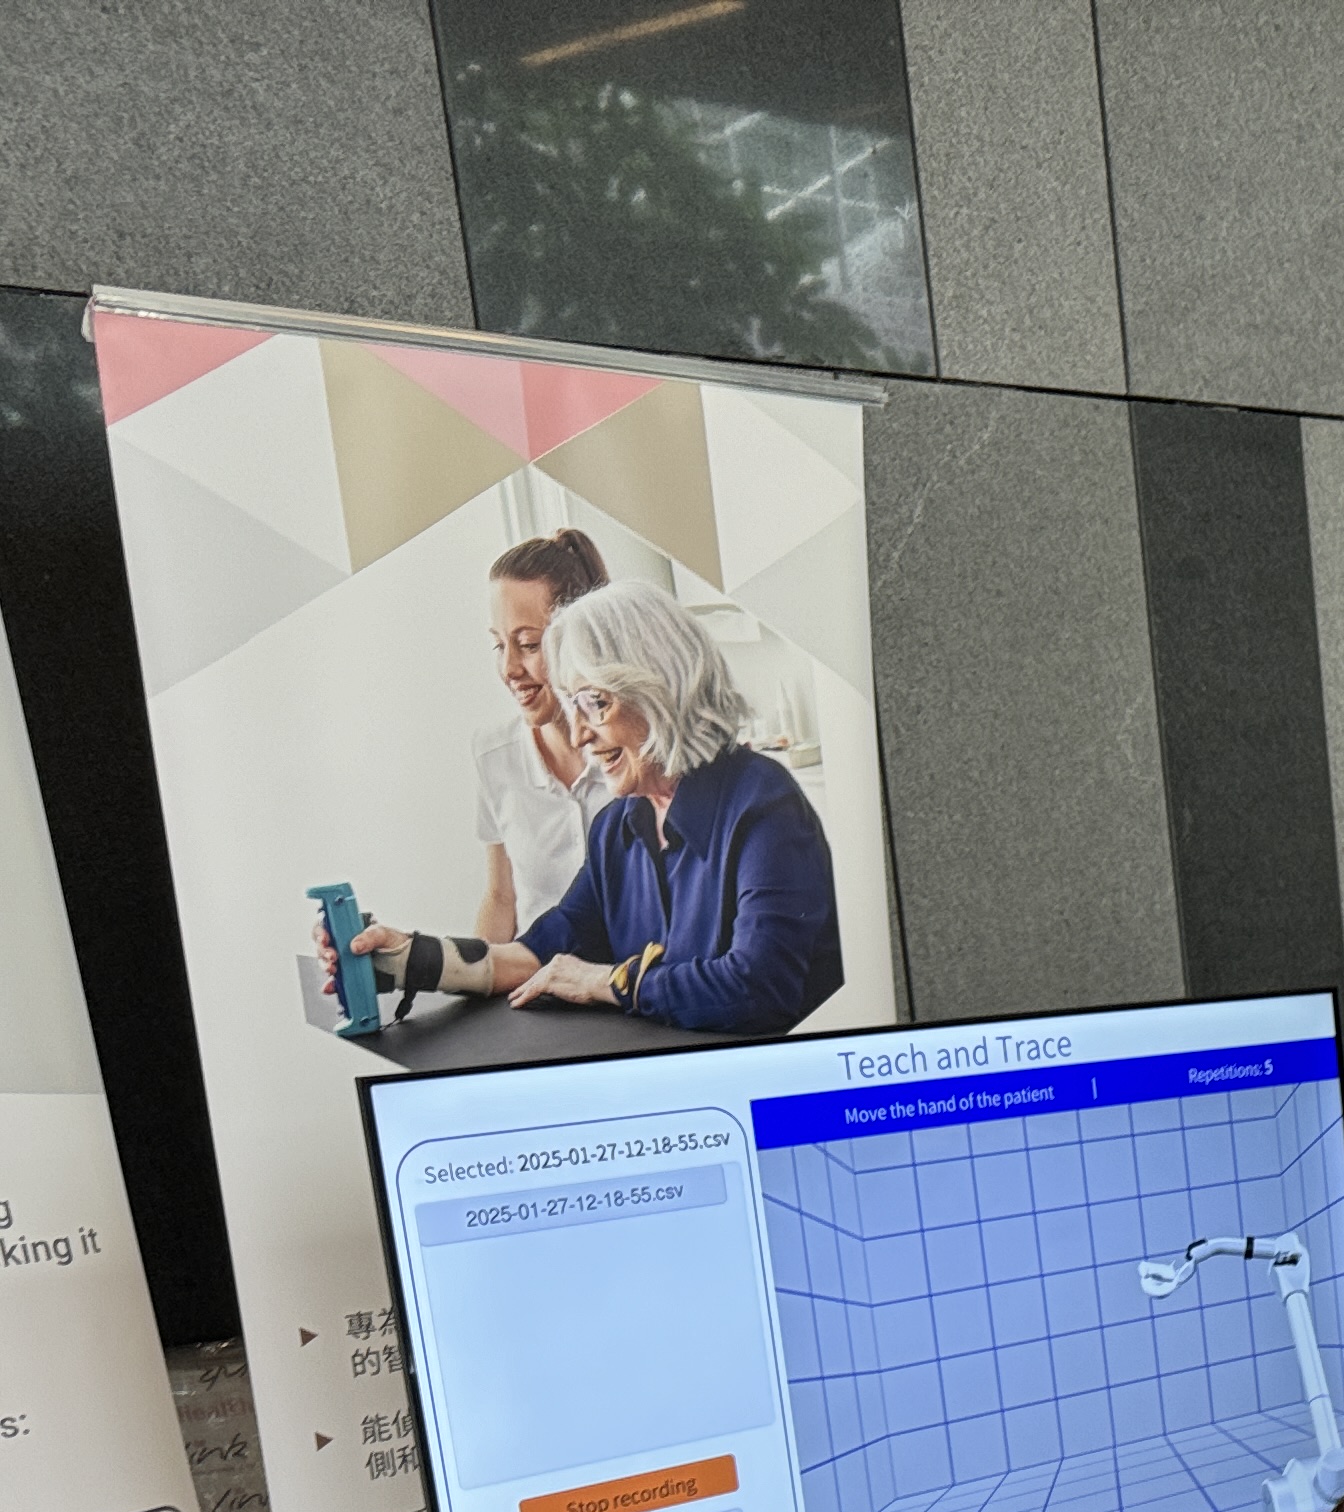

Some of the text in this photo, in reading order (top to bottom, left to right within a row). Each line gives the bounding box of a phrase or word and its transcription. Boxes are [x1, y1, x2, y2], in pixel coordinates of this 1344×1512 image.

[837, 1031, 1073, 1082] Teach and Trace
[1188, 1058, 1274, 1085] Repetitions: 5
[845, 1083, 1055, 1125] Move the hand of the patient
[424, 1131, 731, 1185] Selected: 2025-01-27-12-18-55.csv
[466, 1182, 685, 1229] 2025-01-27-12-18-55.csv
[0, 1226, 102, 1267] king it
[613, 1476, 699, 1508] recording
